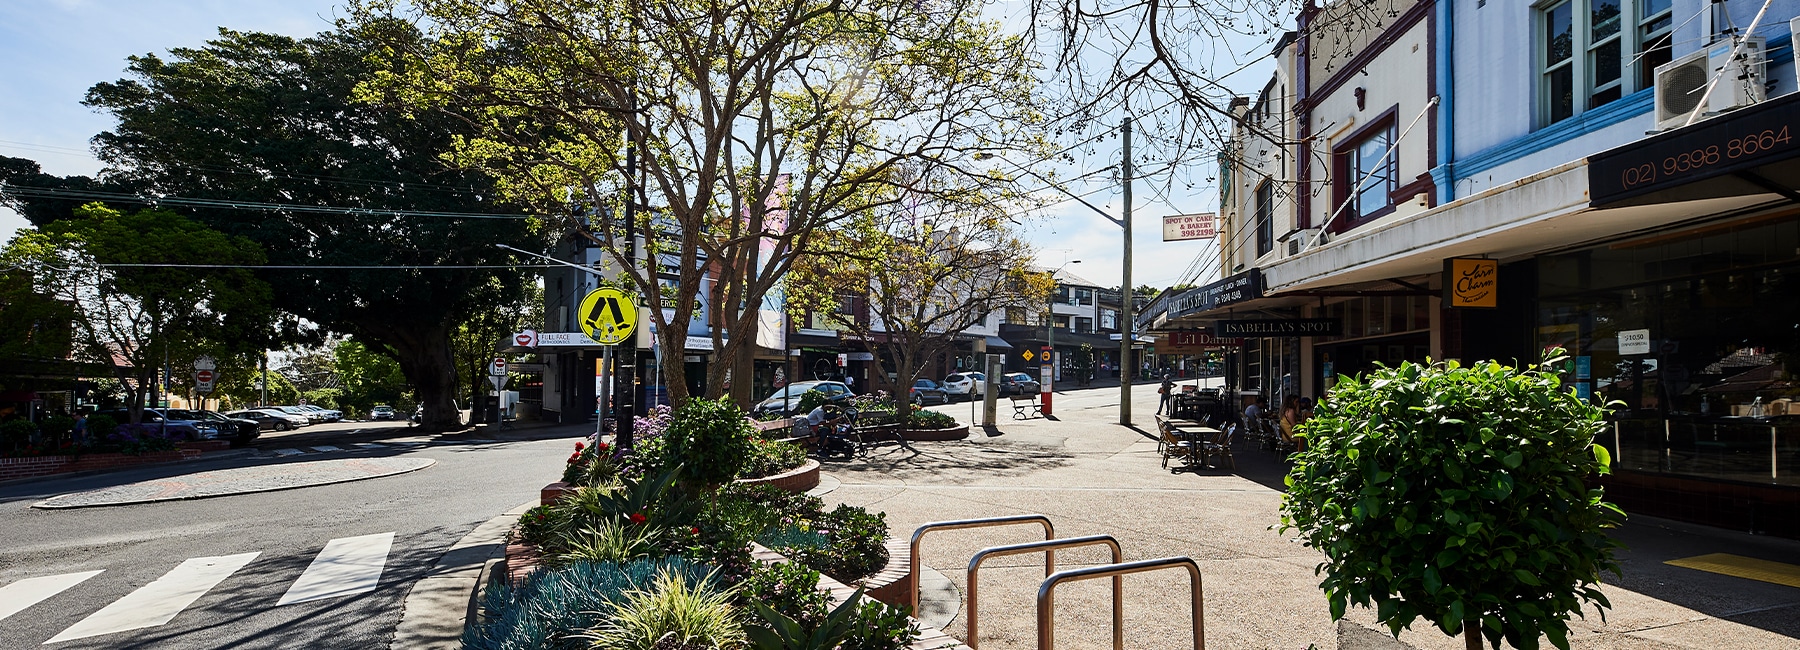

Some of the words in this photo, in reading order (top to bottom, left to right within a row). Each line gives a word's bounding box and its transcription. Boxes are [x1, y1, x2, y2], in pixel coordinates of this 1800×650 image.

[1622, 161, 1657, 190] (02)
[1663, 145, 1721, 176] 9398
[1727, 124, 1793, 159] 8664
[1165, 217, 1182, 225] SPOT
[1181, 229, 1196, 237] 398
[1196, 228, 1214, 236] 2198
[1457, 276, 1493, 292] Charm
[1194, 289, 1209, 308] SPOT
[1226, 321, 1295, 333] ISABELLA'S
[1299, 321, 1333, 332] SPOT
[1177, 332, 1196, 345] Li'l
